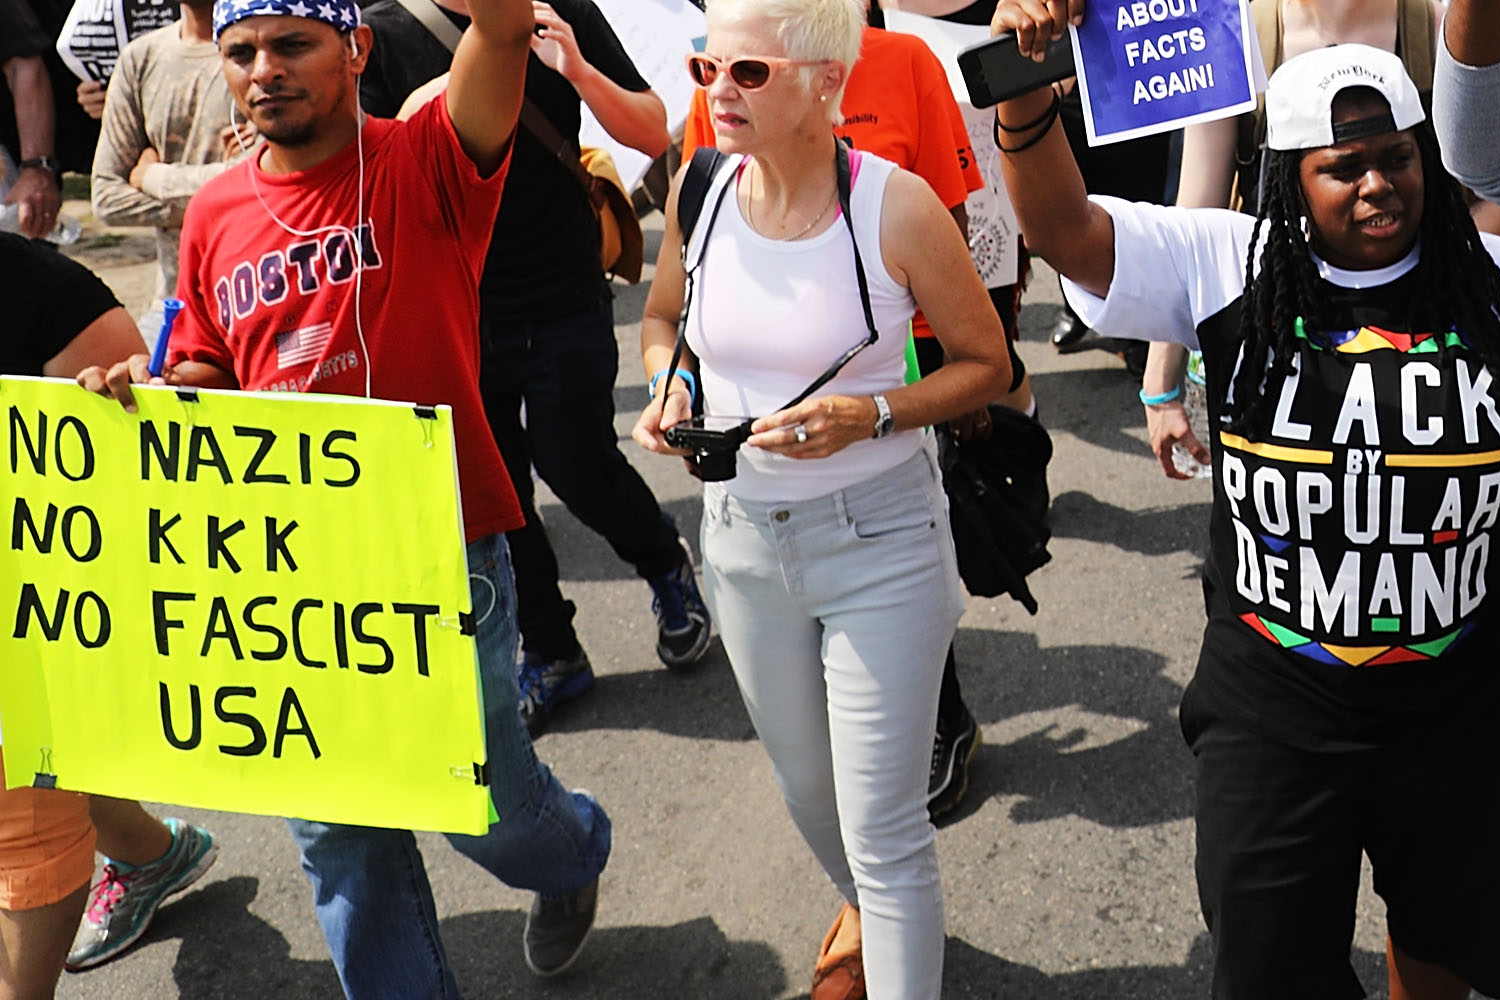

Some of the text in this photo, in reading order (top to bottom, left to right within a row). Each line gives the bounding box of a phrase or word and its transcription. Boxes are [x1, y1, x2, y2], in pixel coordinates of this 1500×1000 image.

[1125, 27, 1206, 68] FACTS
[1132, 63, 1214, 105] AGAIN!
[214, 217, 383, 335] BOSTON
[8, 405, 361, 488] NO NAZIS
[1346, 449, 1382, 475] BY
[11, 497, 300, 573] NO KKK
[1233, 517, 1491, 637] DEMAND
[12, 583, 441, 676] NO FASCIST
[158, 681, 322, 760] USA
